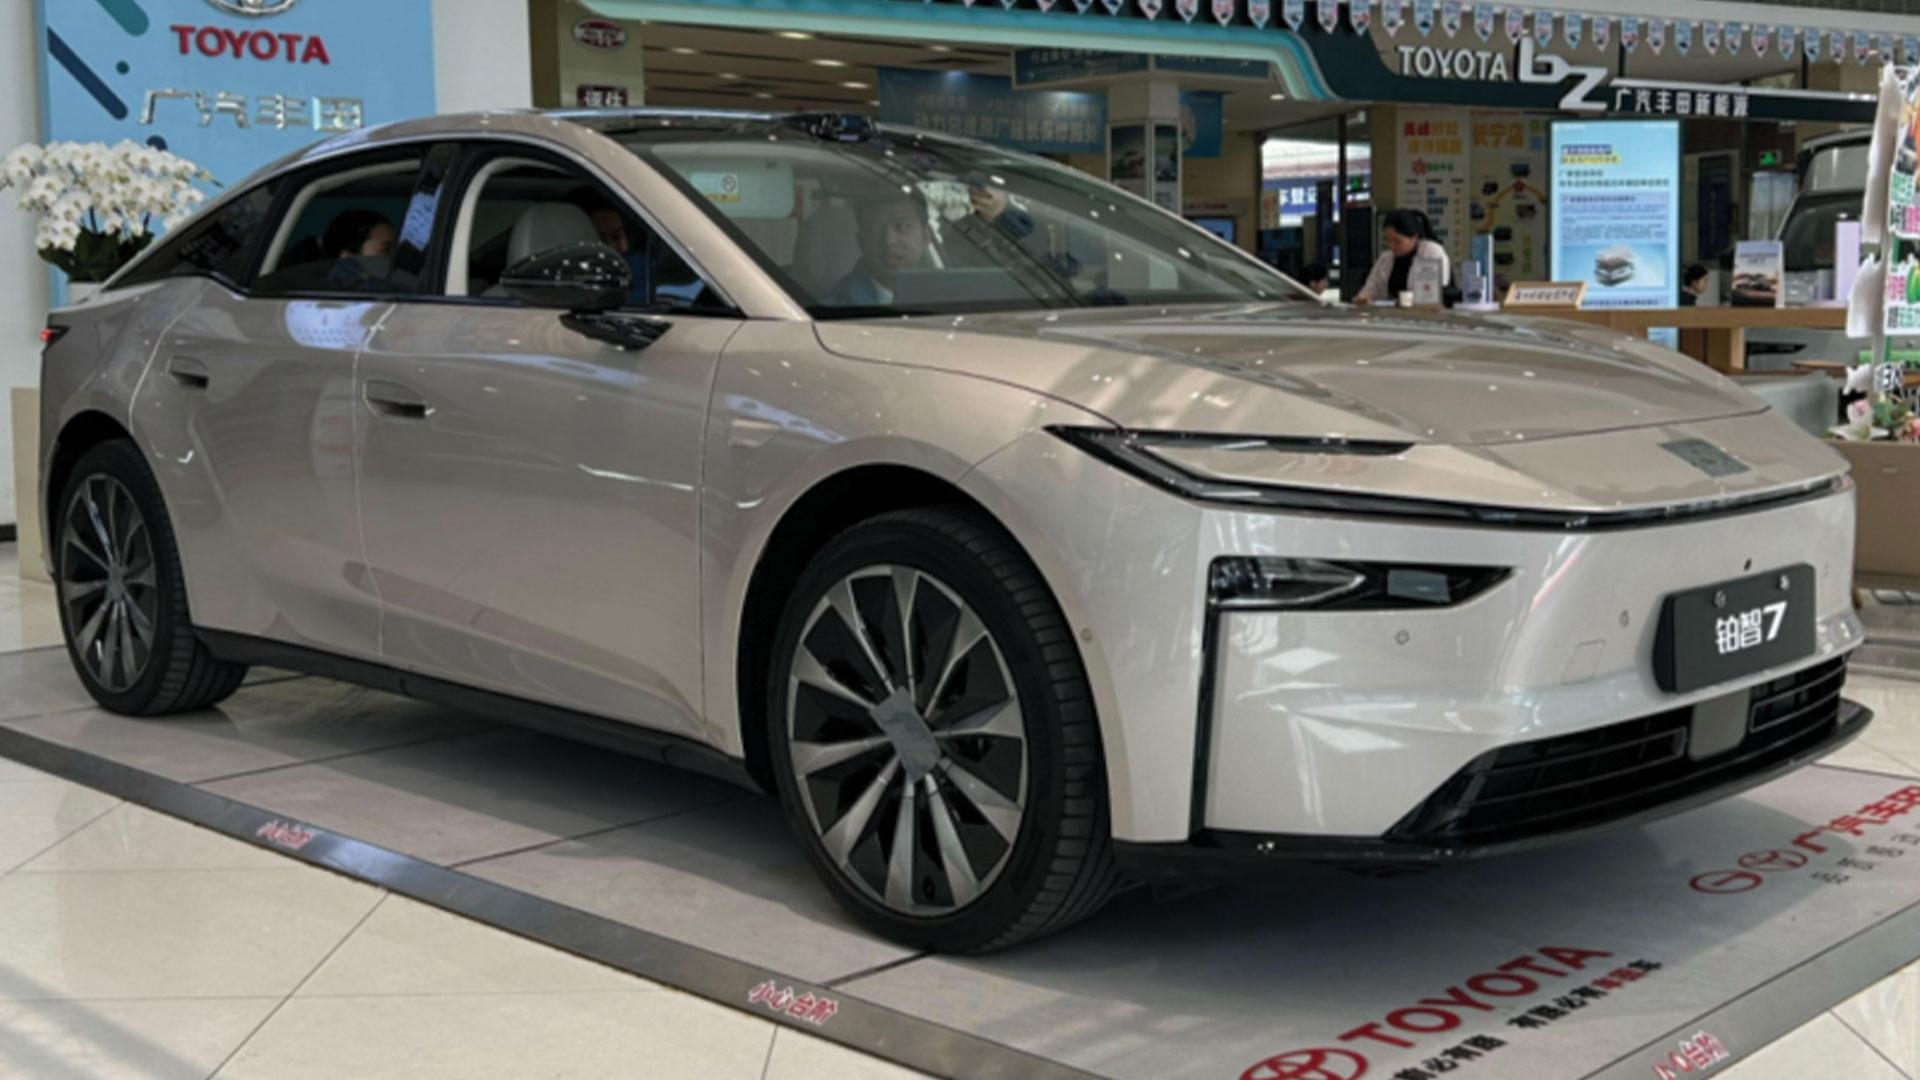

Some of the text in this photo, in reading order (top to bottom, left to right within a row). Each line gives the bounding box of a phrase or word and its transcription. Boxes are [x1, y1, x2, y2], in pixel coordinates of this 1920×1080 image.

[170, 25, 330, 65] TOYOTA
[1397, 46, 1509, 81] TOYOTA
[139, 88, 364, 131] 广汽丰田
[1614, 88, 1749, 117] 广汽丰田新能源
[1716, 601, 1788, 654] 铂智7
[749, 981, 837, 1026] 小心台阶
[1337, 945, 1614, 1048] TOYOTA
